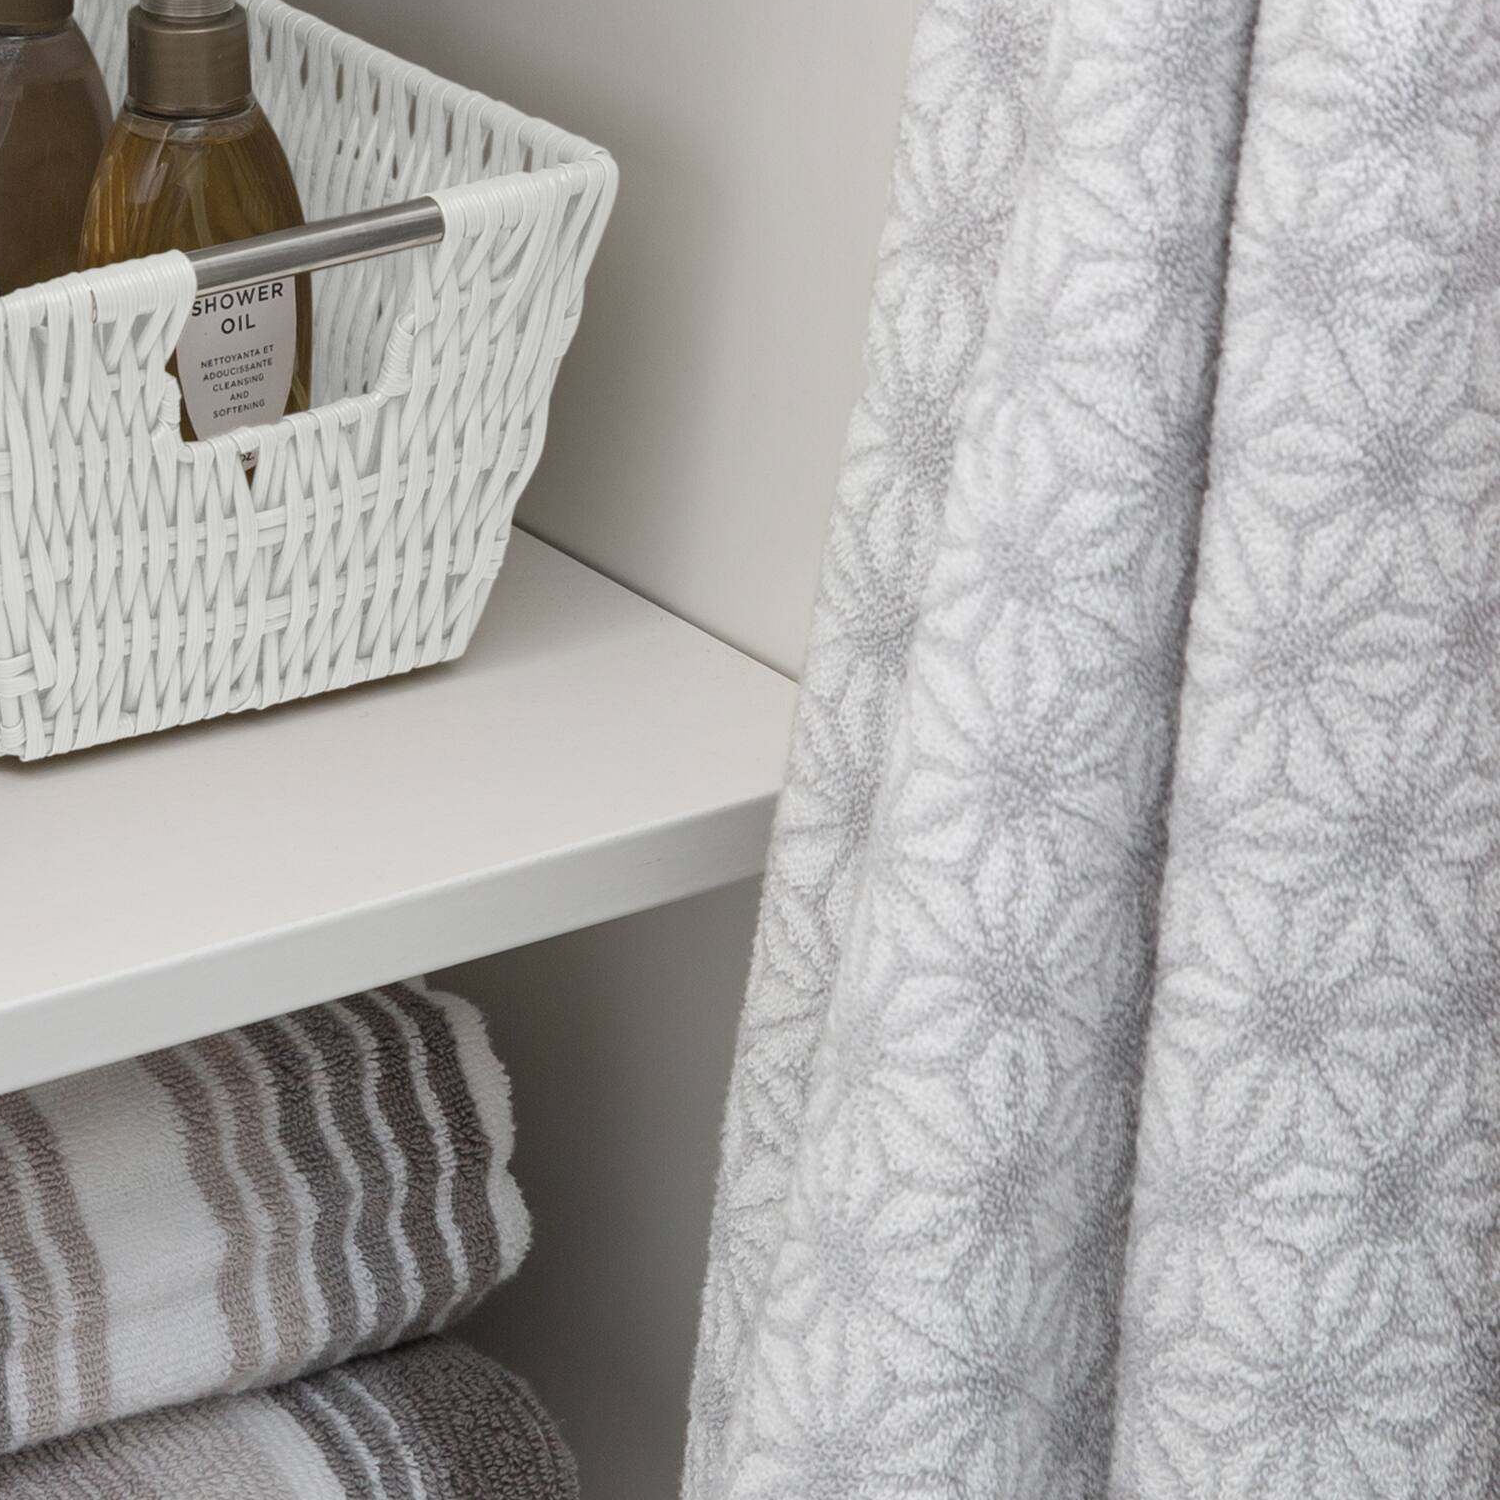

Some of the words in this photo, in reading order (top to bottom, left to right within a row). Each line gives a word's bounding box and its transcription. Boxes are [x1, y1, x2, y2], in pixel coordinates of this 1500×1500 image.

[191, 282, 284, 317] SHOWER
[221, 313, 256, 334] OIL
[263, 344, 275, 355] ET
[203, 357, 273, 381] ADOUCISSANTE
[212, 373, 265, 392] CLEANSING
[230, 390, 250, 402] AND
[212, 399, 266, 419] SOFTENING
